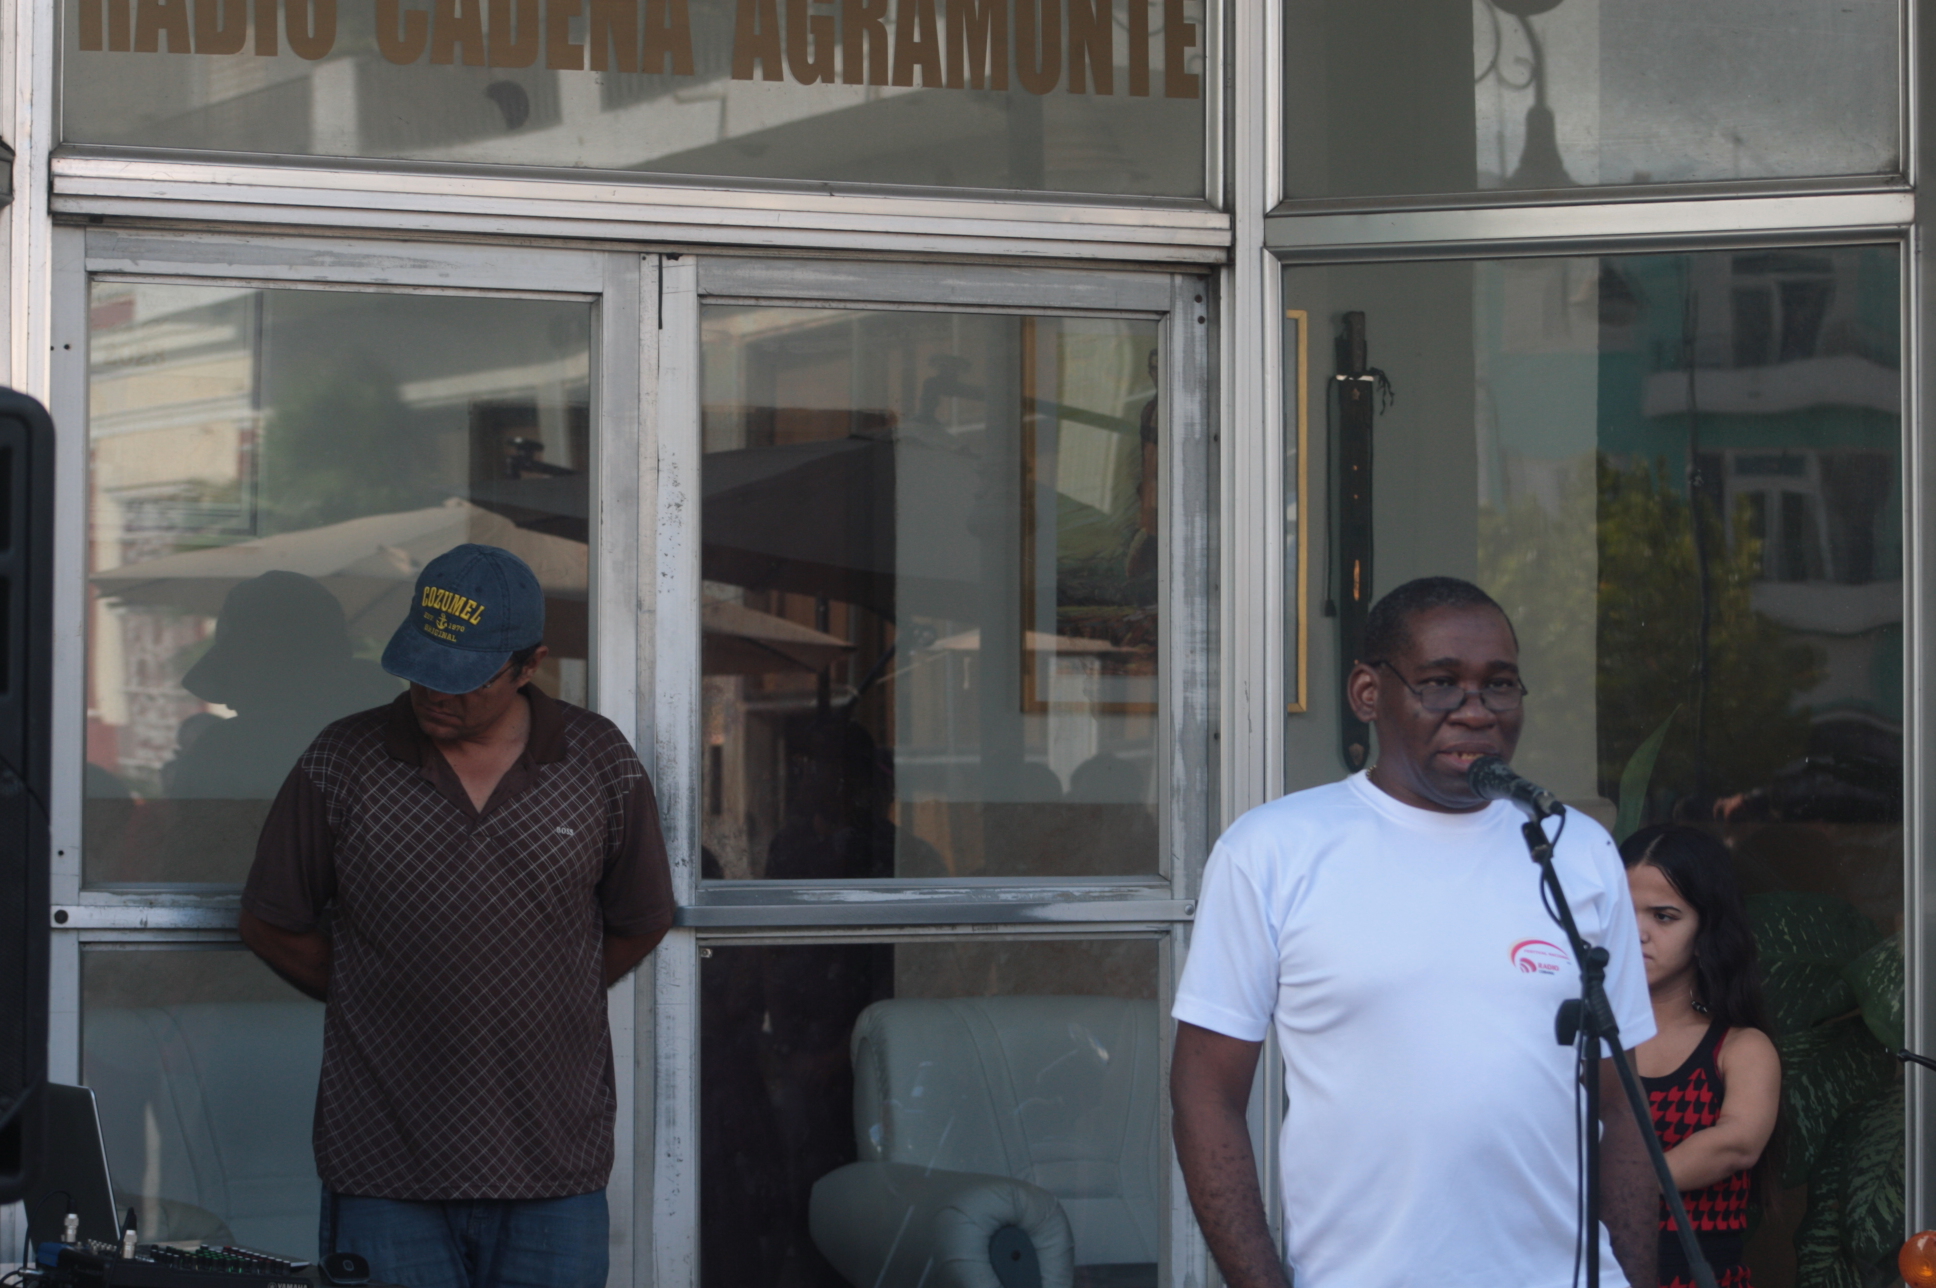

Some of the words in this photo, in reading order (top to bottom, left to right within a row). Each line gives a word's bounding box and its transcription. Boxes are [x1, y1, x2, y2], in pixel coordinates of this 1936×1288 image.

[731, 0, 1200, 99] AGRAMONTE
[422, 586, 485, 625] COZUMEL
[424, 624, 457, 642] ORIGINAL
[448, 623, 466, 632] 1970
[1538, 962, 1559, 971] RADIO
